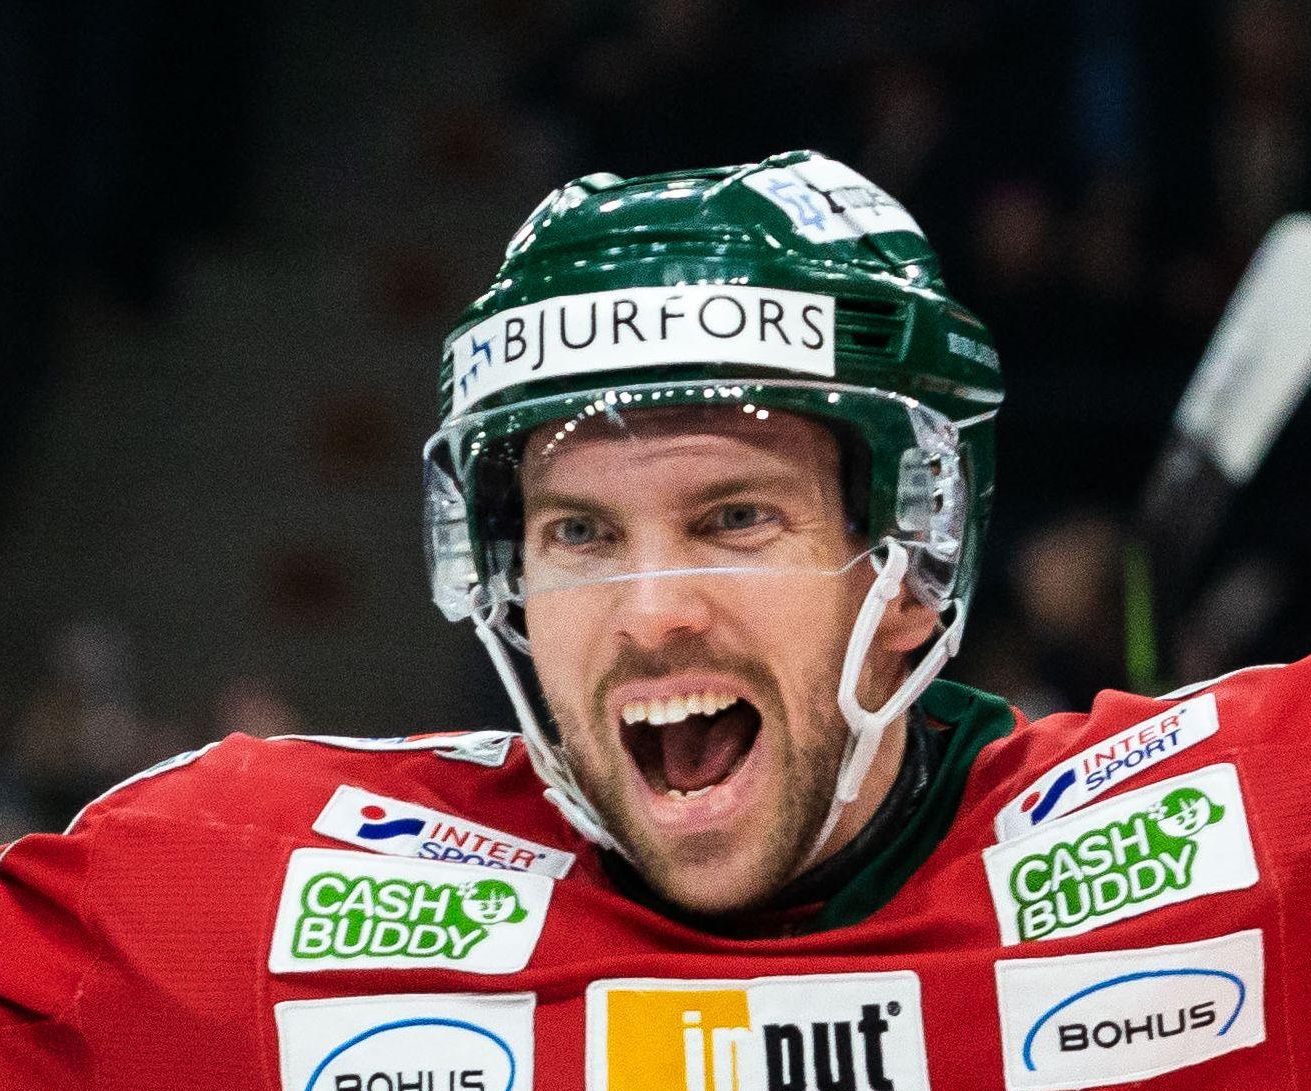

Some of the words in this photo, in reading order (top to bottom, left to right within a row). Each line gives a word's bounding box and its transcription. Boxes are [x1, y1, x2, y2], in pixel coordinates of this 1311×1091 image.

[504, 295, 825, 371] BJURFORS
[1082, 714, 1181, 774] INTER
[1085, 729, 1182, 792] SPORT
[418, 841, 528, 873] SPO
[429, 821, 537, 869] INTER
[1016, 818, 1151, 901] CASH
[306, 877, 447, 923] CASH
[1022, 843, 1196, 940] BUDDY
[295, 916, 487, 959] BUDDY
[1057, 1001, 1217, 1052] BOHUS
